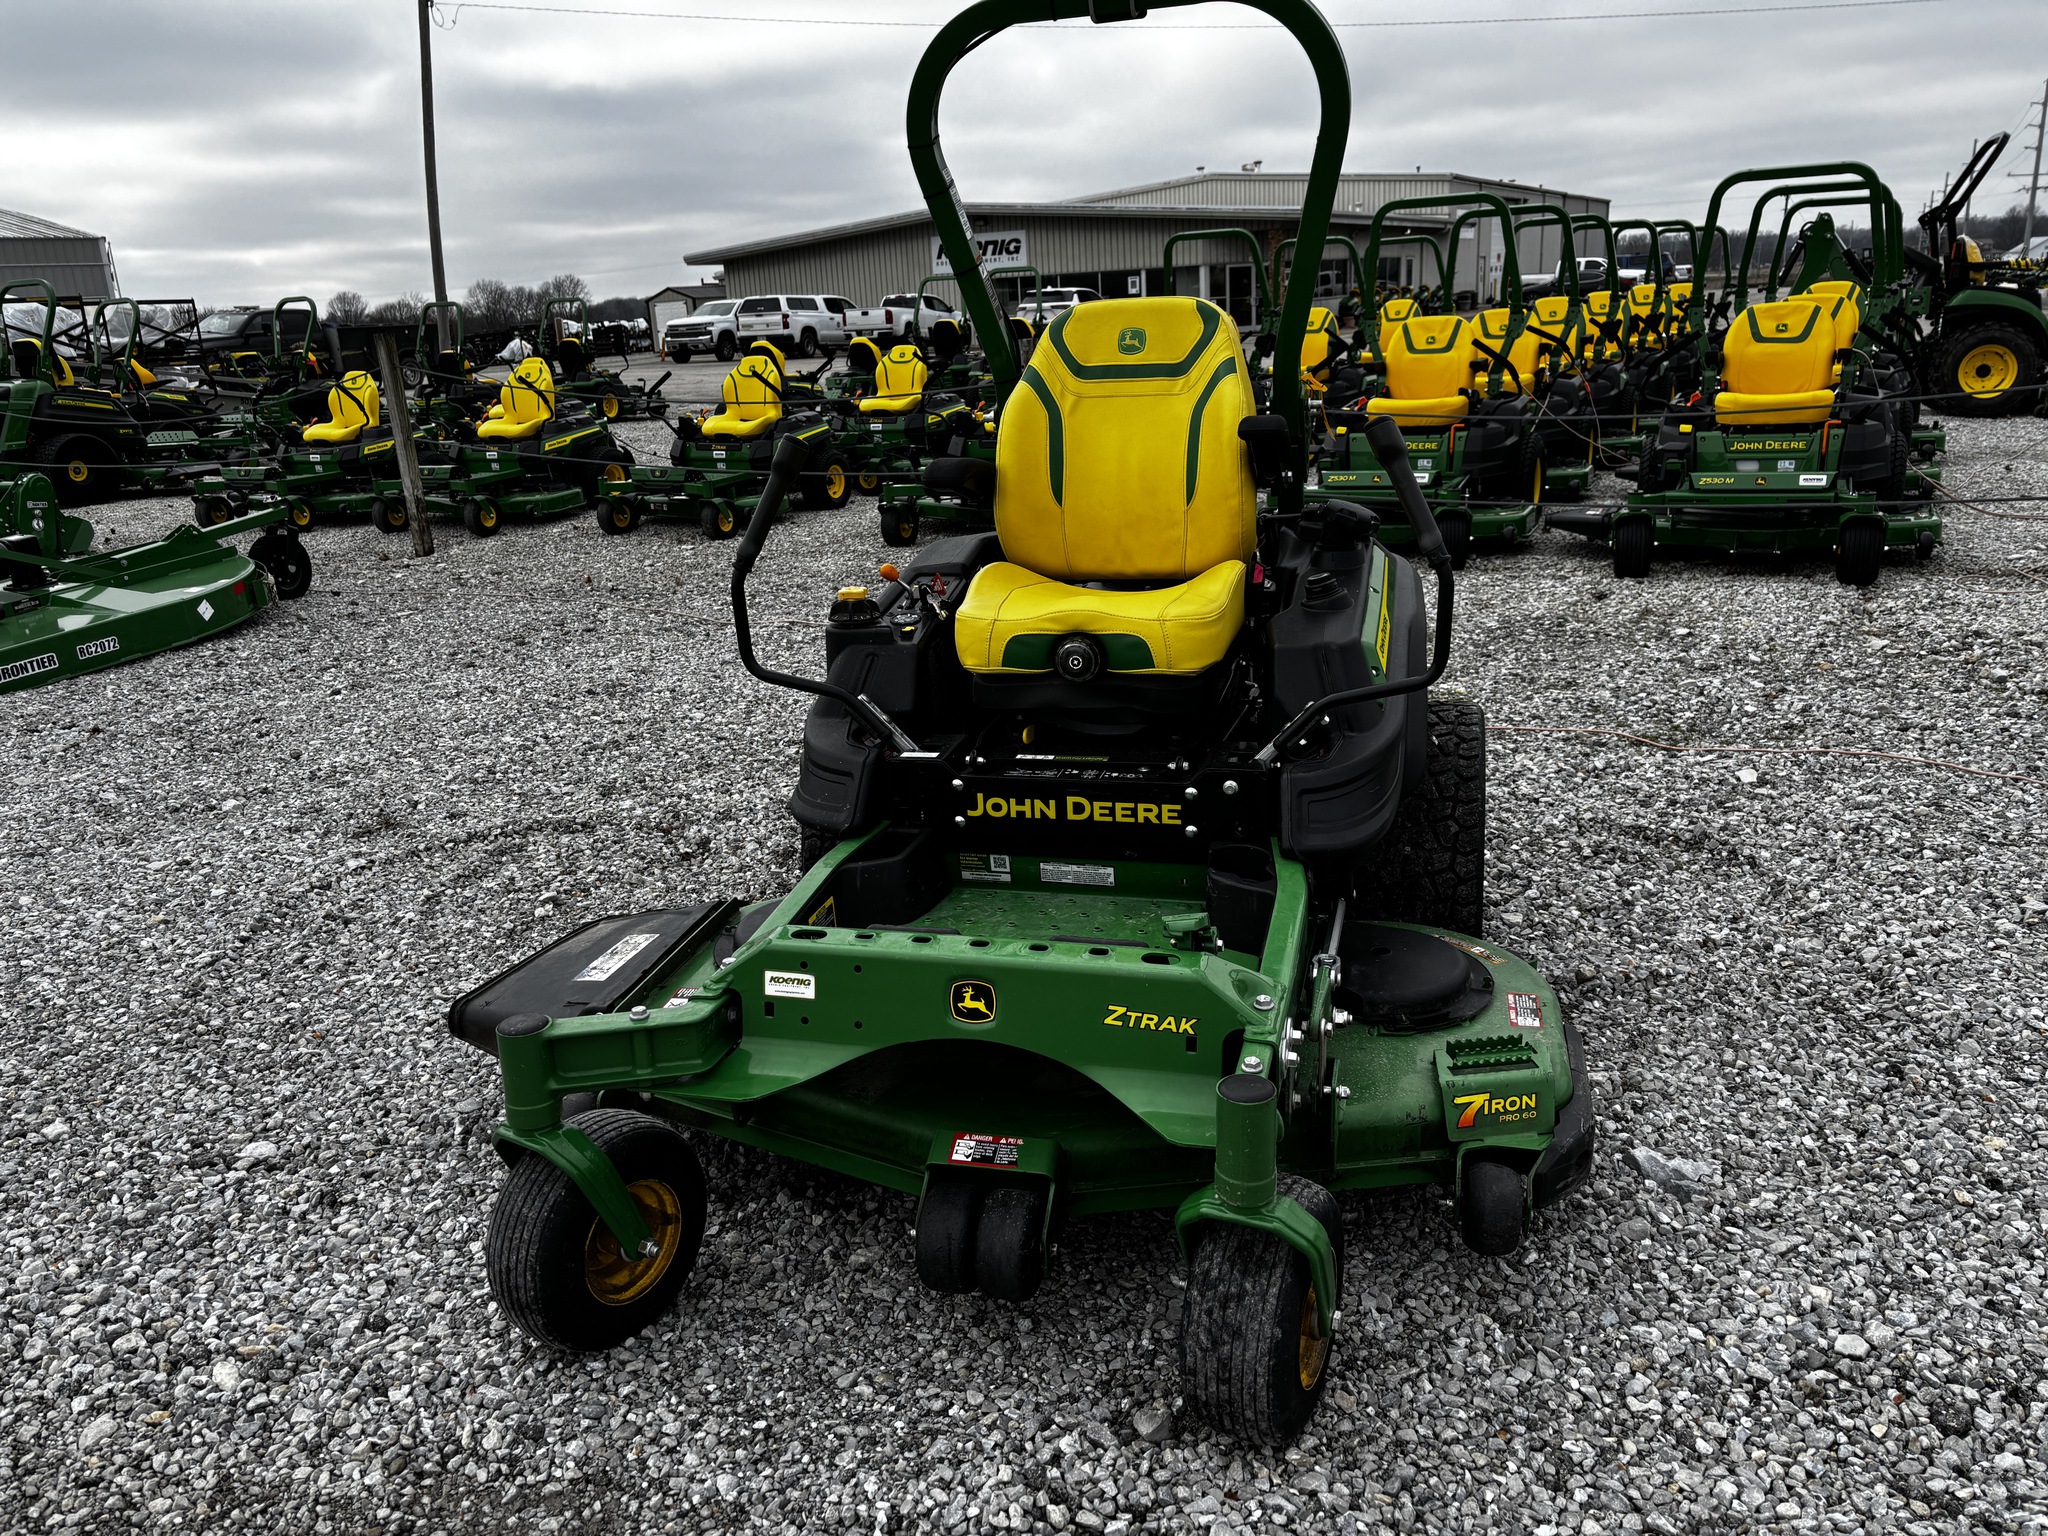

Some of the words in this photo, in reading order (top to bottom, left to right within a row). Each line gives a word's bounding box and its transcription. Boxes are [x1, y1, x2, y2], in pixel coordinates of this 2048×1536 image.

[1730, 441, 1762, 450] JOHN
[1765, 441, 1806, 450] DEERE
[78, 638, 118, 658] RC2072
[0, 654, 57, 682] RONTIER
[967, 793, 1056, 819] JOHN
[1066, 796, 1182, 824] DEERE
[1103, 1005, 1198, 1035] ZTRAK
[1500, 1113, 1520, 1123] PRO
[1522, 1111, 1537, 1119] 60
